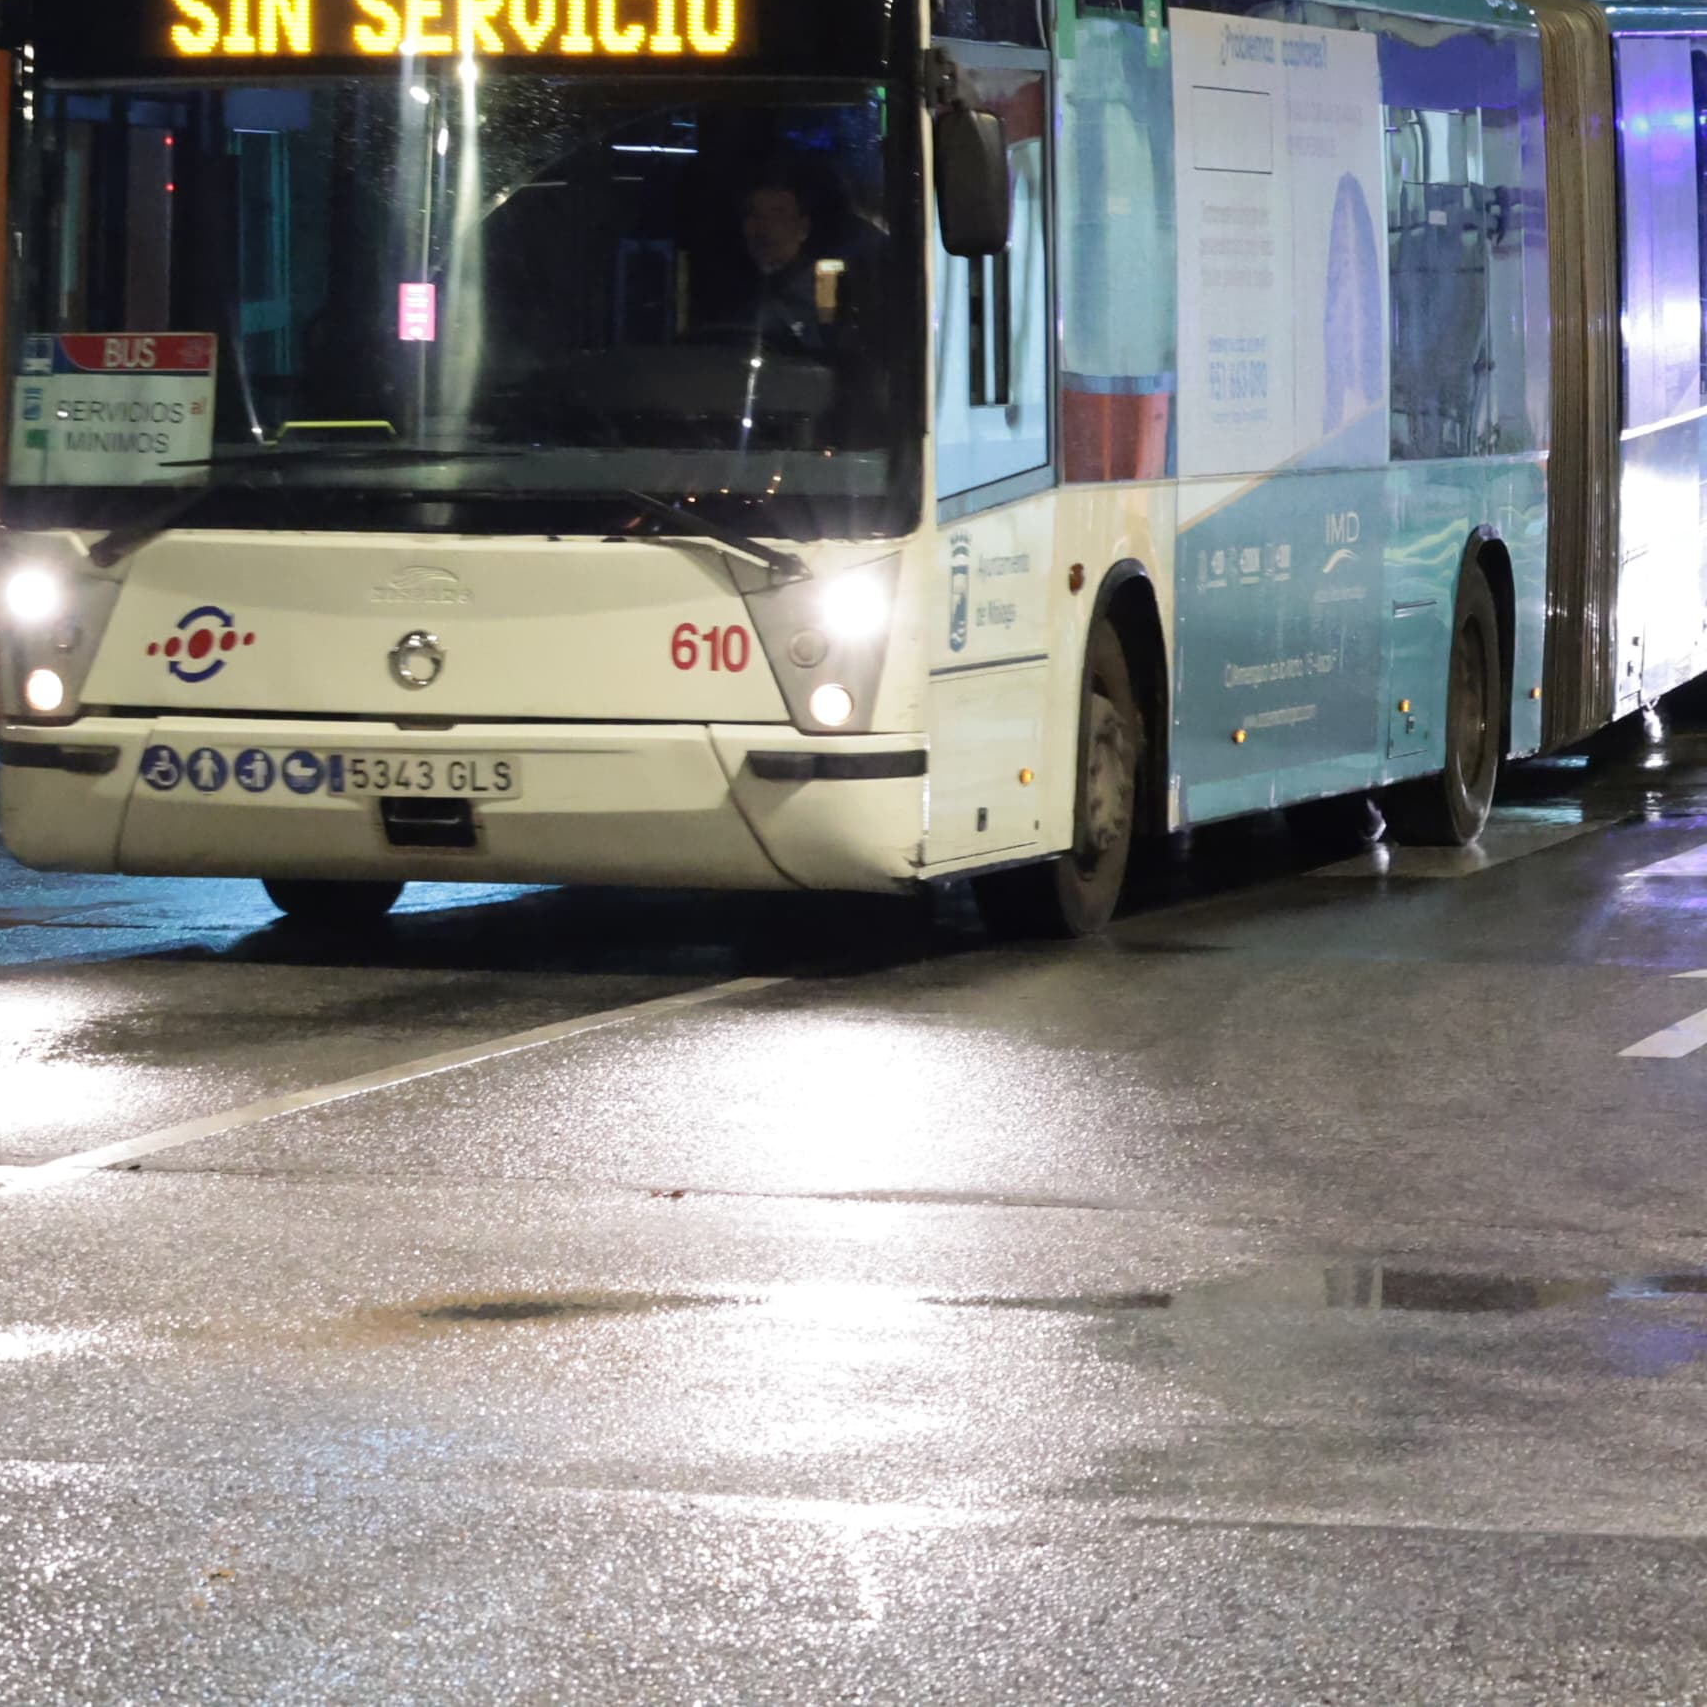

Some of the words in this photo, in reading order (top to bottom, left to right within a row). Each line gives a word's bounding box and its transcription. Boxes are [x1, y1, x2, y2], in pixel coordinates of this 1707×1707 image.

[104, 337, 157, 369] BUS
[56, 400, 186, 424] SERVICIOS
[1325, 511, 1361, 545] IMD
[671, 622, 750, 672] 610
[350, 757, 436, 791] 5343
[447, 760, 513, 792] GLS
